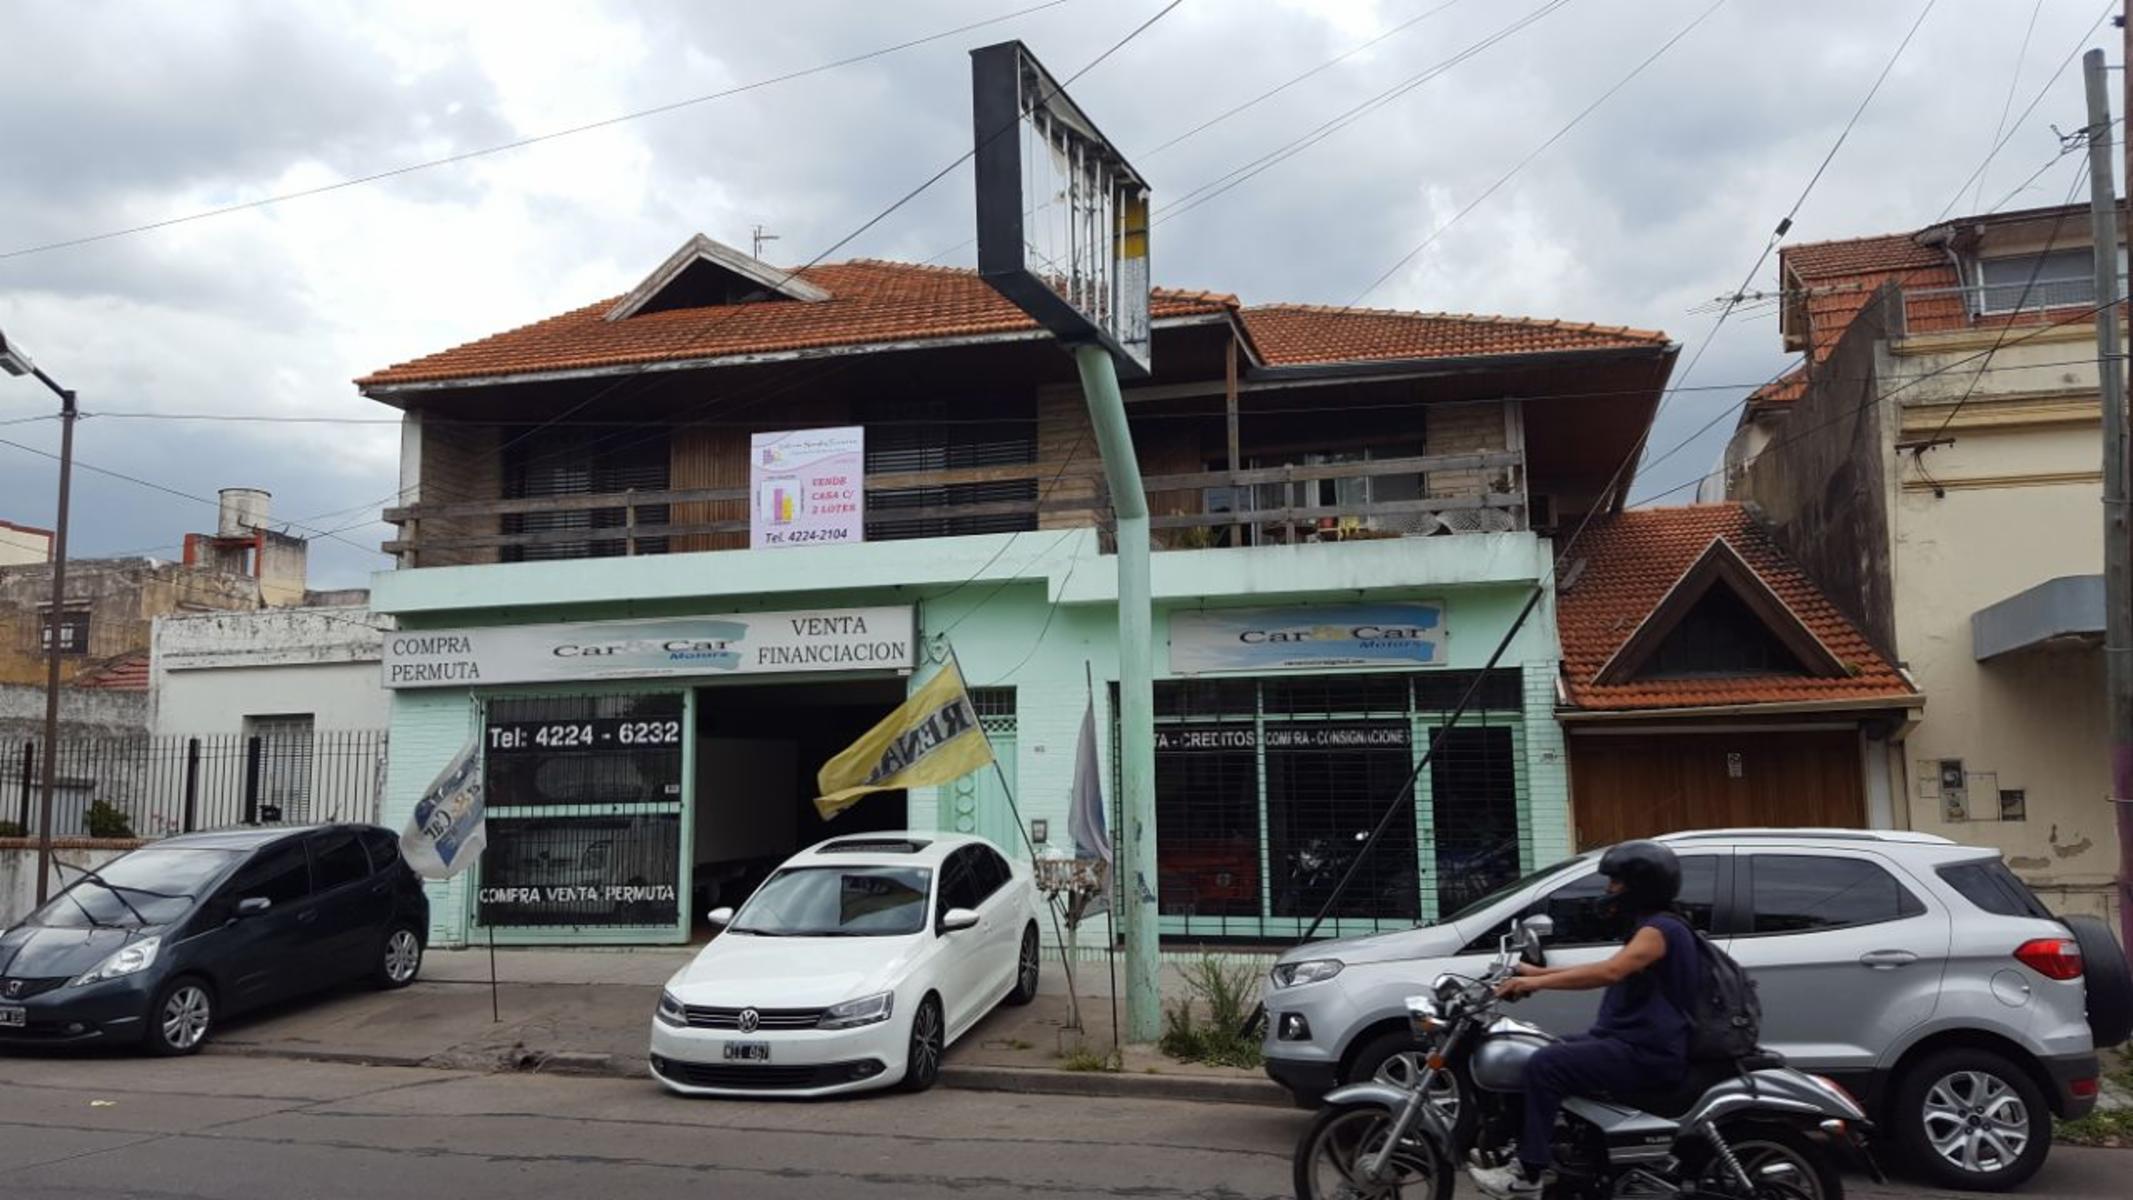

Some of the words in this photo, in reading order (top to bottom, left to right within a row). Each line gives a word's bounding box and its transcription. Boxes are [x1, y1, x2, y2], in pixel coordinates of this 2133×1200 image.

[811, 490, 839, 501] CASA
[787, 528, 848, 542] 4224-2104
[791, 616, 867, 636] VENTA
[1239, 631, 1311, 645] Car
[1353, 626, 1427, 641] Car
[393, 636, 472, 656] COMPRA
[553, 645, 622, 657] Car
[663, 640, 735, 652] Car
[758, 642, 905, 665] FINANCIACION
[1360, 640, 1422, 649] Motors
[669, 651, 729, 661] Motors
[391, 661, 480, 682] PERMUTA
[490, 727, 527, 748] Tel:
[535, 724, 594, 747] 4224
[618, 721, 680, 744] 6232
[479, 886, 541, 903] COMPRA
[546, 886, 599, 901] VENTA
[605, 884, 675, 903] PERMUTA
